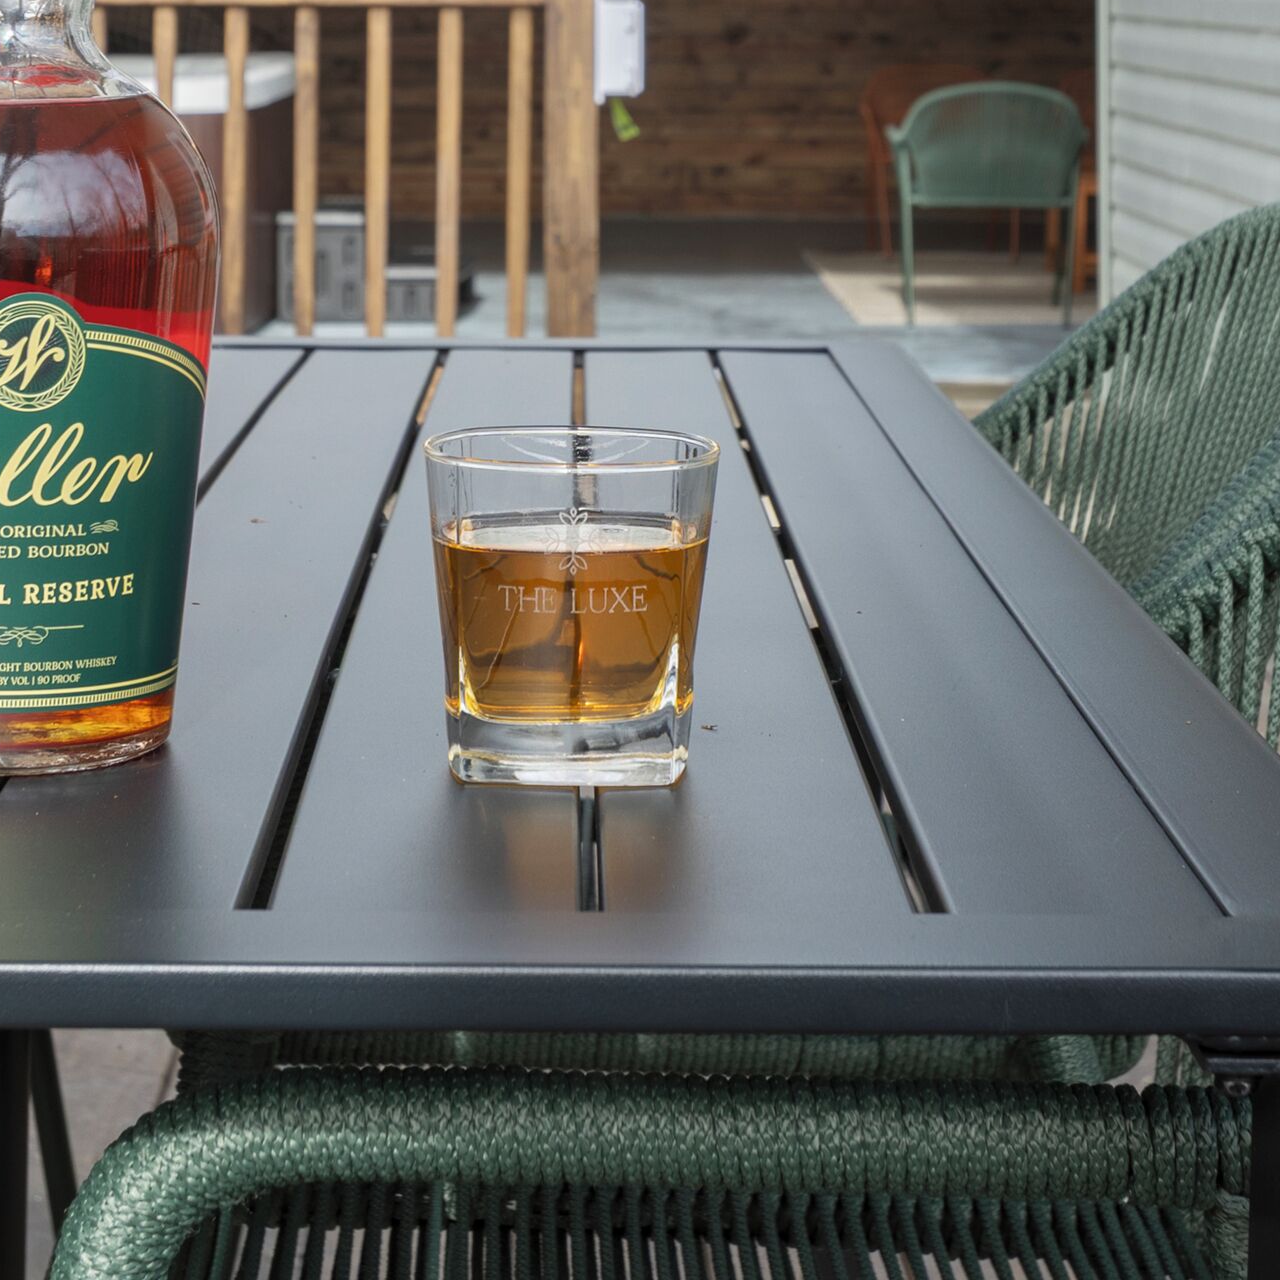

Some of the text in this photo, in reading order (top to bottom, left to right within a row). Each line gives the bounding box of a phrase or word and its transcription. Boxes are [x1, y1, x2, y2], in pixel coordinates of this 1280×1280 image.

[0, 523, 87, 538] ORIGINAL
[27, 542, 110, 559] BOURBON
[23, 573, 134, 605] RESERVE
[497, 584, 648, 614] THE LUXE
[23, 660, 73, 672] BOURBON
[75, 655, 118, 669] WHISKEY
[10, 676, 30, 686] VOL
[37, 675, 50, 685] 90
[51, 673, 81, 684] PROOF
